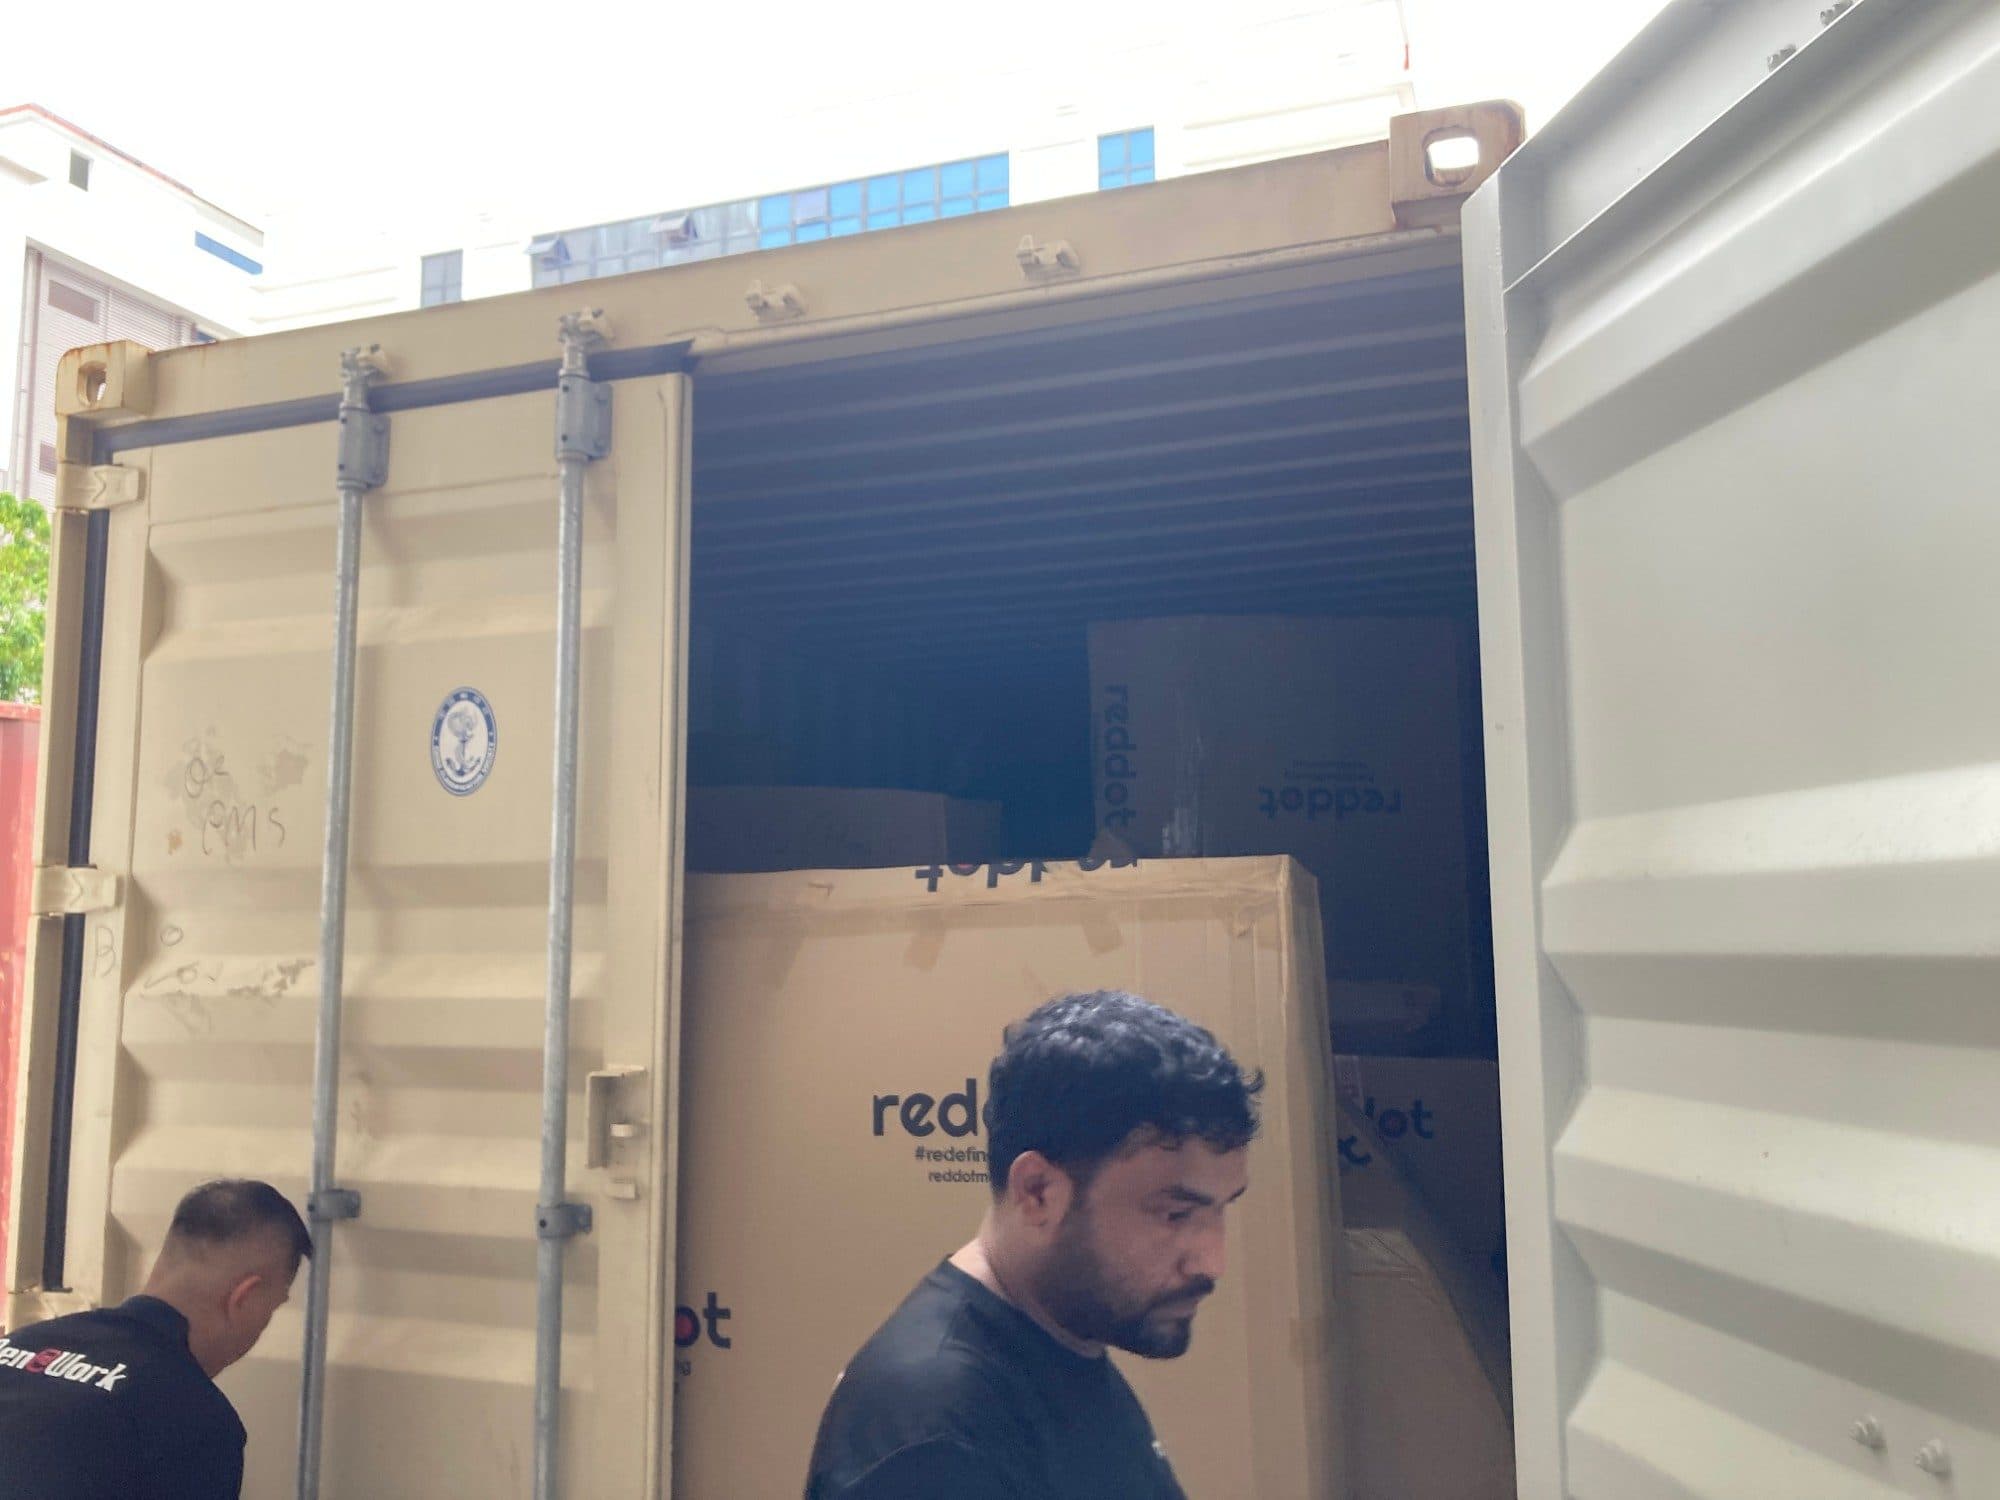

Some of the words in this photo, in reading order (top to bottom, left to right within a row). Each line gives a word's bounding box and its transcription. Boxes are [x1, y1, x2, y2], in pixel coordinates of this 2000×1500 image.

[1104, 684, 1137, 828] reddot
[1257, 785, 1403, 822] reddot
[873, 1078, 988, 1138] red
[914, 1144, 988, 1162] #redefin
